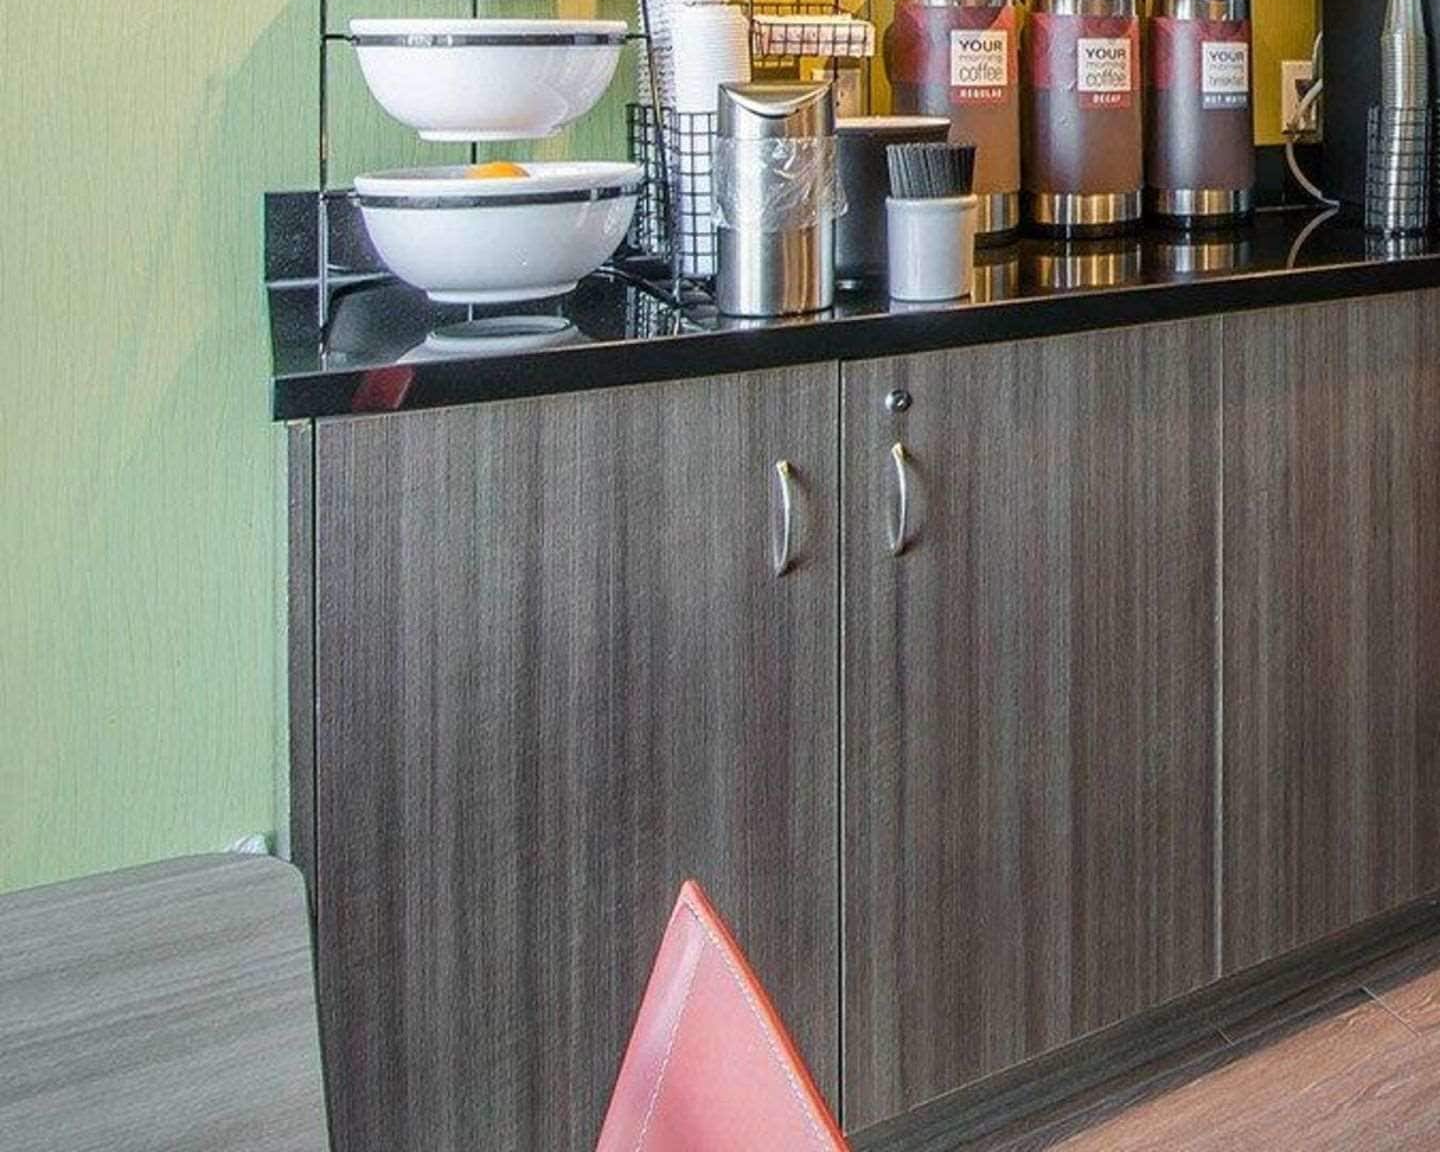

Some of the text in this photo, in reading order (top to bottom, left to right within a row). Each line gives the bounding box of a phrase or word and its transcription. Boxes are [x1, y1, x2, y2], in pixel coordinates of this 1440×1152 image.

[959, 39, 1003, 53] YOUR
[1086, 48, 1126, 60] YOUR
[1209, 50, 1245, 62] YOUR
[959, 62, 1003, 82] coffee
[1086, 69, 1126, 87] coffee
